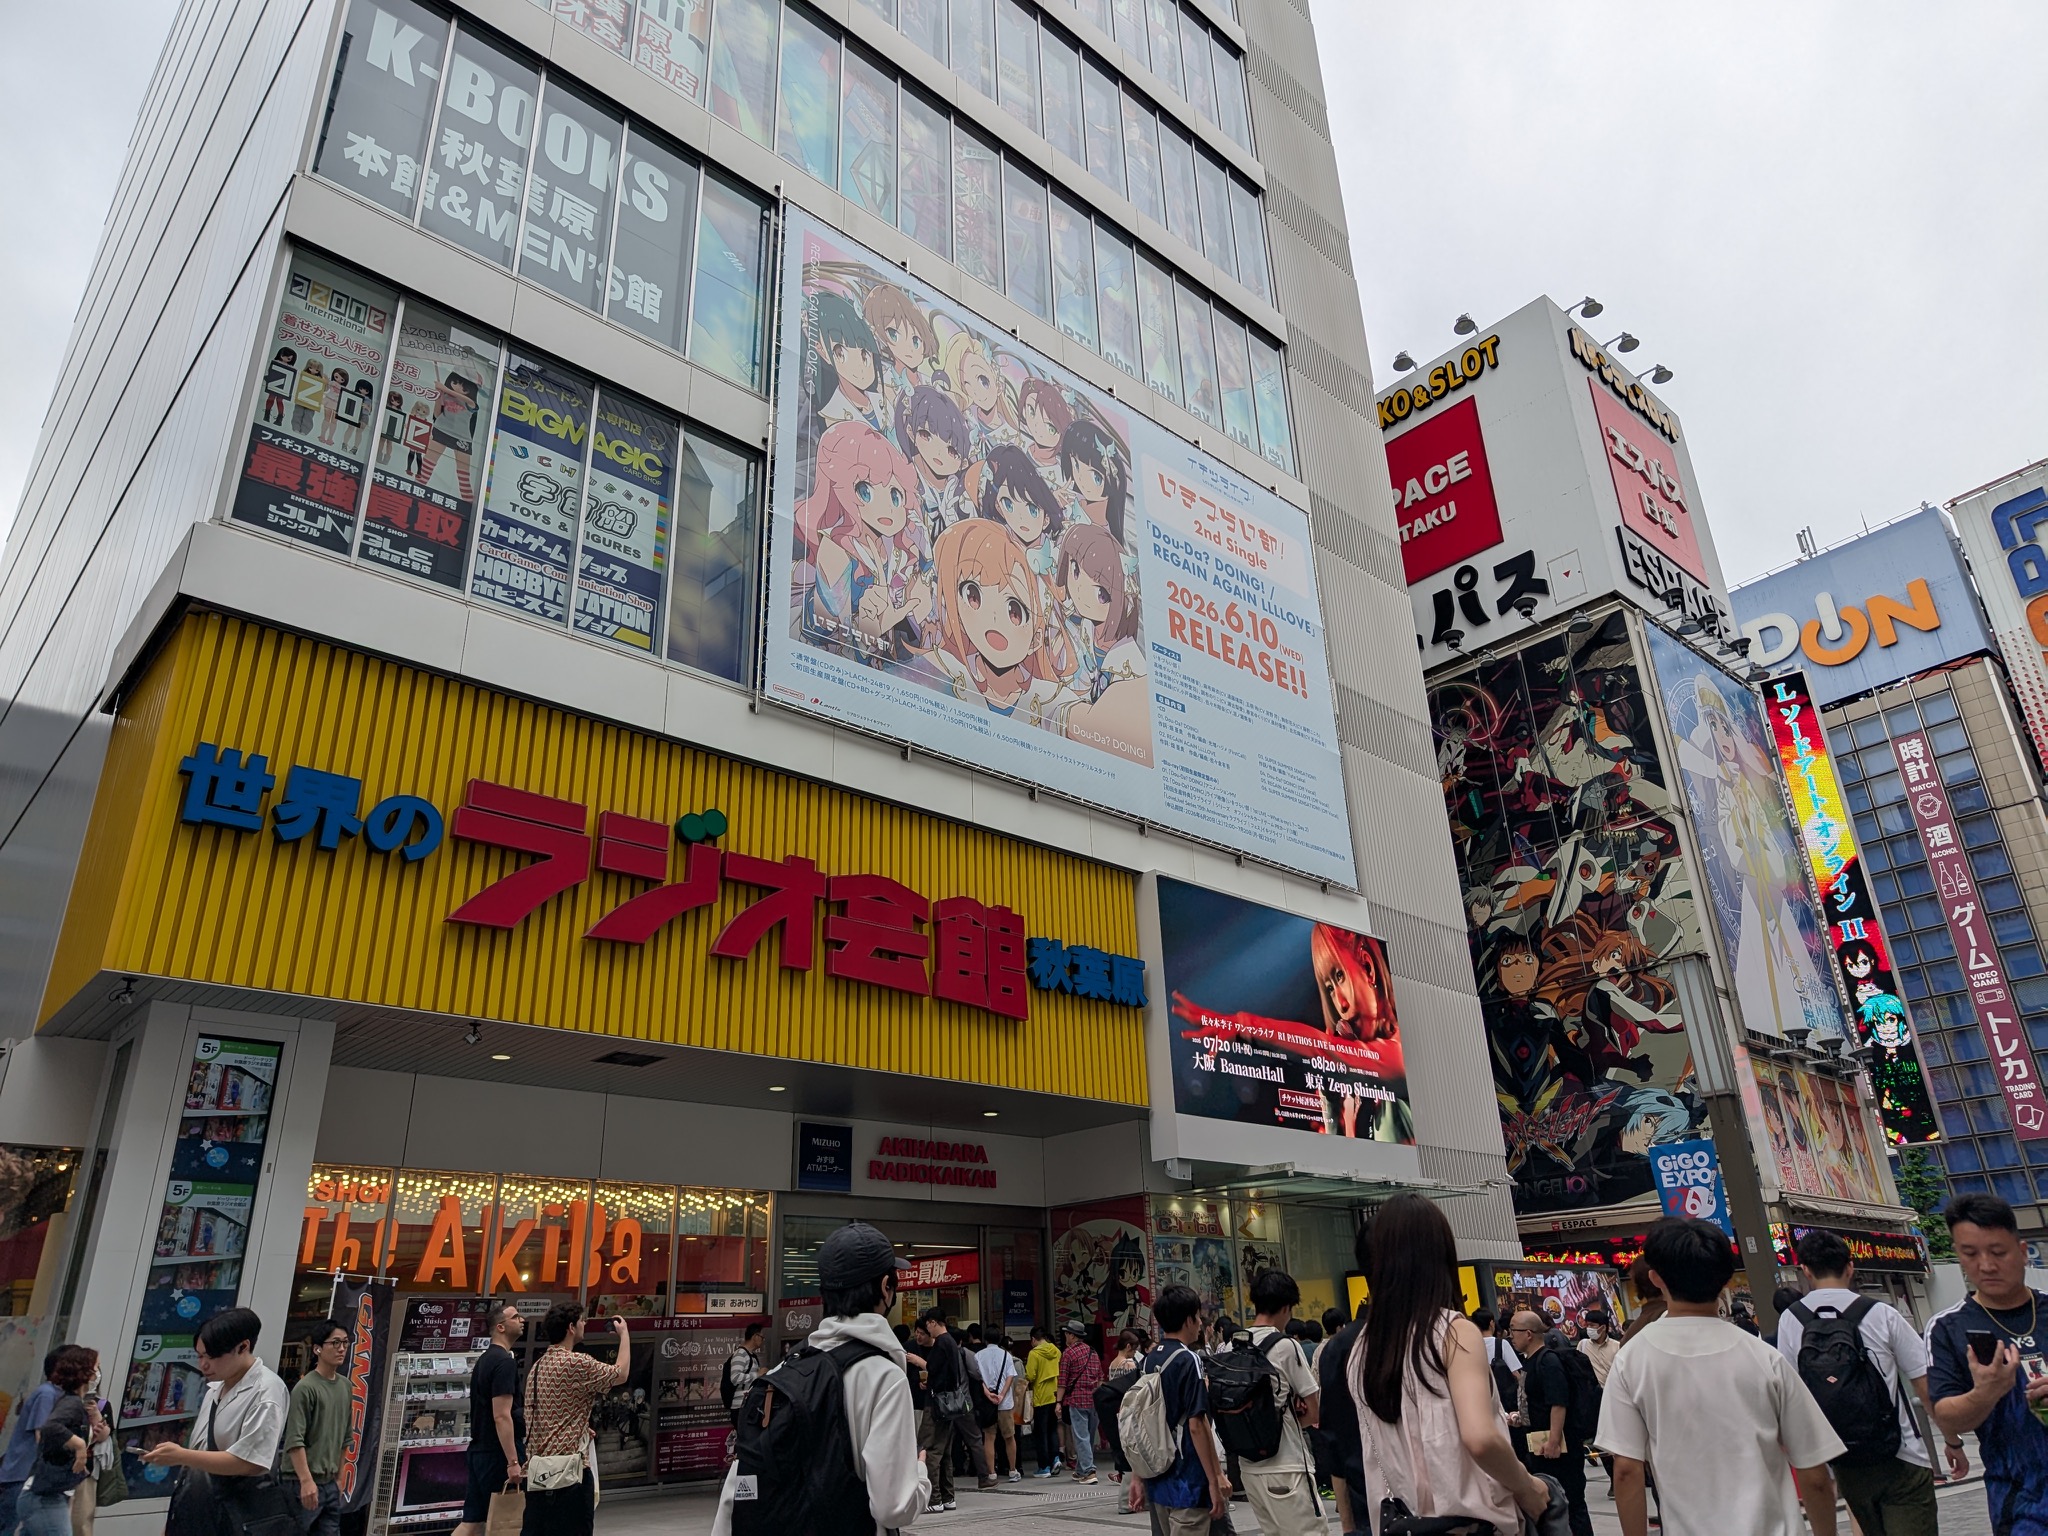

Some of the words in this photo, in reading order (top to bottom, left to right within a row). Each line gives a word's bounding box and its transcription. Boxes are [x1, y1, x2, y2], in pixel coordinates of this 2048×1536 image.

[366, 8, 670, 223] K-BOOKS
[440, 125, 601, 242] 秋葉原
[343, 128, 664, 325] 本館&MEN'S館
[811, 242, 820, 284] REGAIN
[289, 273, 387, 333] azone
[304, 303, 367, 335] International
[808, 287, 819, 326] AGAIN
[261, 430, 360, 474] フィギュア・おもちゃ
[373, 472, 458, 511] 中古買取・販売
[622, 465, 641, 480] CARD
[643, 474, 662, 487] SHOP
[1604, 426, 1688, 514] エスパス
[267, 513, 320, 538] ジャングル
[368, 547, 433, 575] 秋葉原2号店
[365, 520, 385, 532] OBBY
[387, 528, 408, 539] SHOP
[510, 502, 551, 526] TOYS
[558, 521, 569, 533] &
[583, 530, 642, 559] IGURES
[1193, 520, 1222, 546] 2nd
[1226, 537, 1268, 570] Single
[1153, 543, 1207, 582] REGAIN
[1213, 575, 1257, 608] AGAIN
[1215, 558, 1265, 593] DOING!
[474, 578, 620, 637] ホビーステション
[626, 594, 653, 612] Shop
[1417, 549, 1550, 651] パス
[1166, 580, 1279, 650] 2026.6.10
[1280, 644, 1304, 665] (WED)
[1168, 608, 1308, 699] RELEASE!!
[1073, 724, 1111, 746] Dou-Da?
[1112, 739, 1146, 759] DOING!
[1898, 737, 1932, 783] 時計
[1910, 780, 1937, 793] WATCH
[1926, 822, 1954, 848] 酒
[1931, 847, 1959, 859] ALCOHOL
[179, 742, 445, 864] 世界の
[444, 778, 1028, 1021] ラジオ会館
[1025, 937, 1149, 1008] 秋葉原
[1952, 901, 1994, 971] ゲーム
[1970, 970, 1998, 983] VIDEO
[1973, 976, 2000, 988] GAME
[201, 1042, 219, 1054] 5F
[1234, 1023, 1274, 1039] ワンマンライブ
[1277, 1031, 1285, 1040] RI
[1285, 1033, 1312, 1047] PATHOS
[1313, 1040, 1328, 1050] LIVE
[1328, 1043, 1336, 1051] in
[1336, 1044, 1380, 1061] OSAKA/TOKYO
[1987, 1011, 2028, 1081] トレカ
[1192, 1051, 1216, 1073] 大阪
[1219, 1057, 1285, 1083] BananaHall
[1304, 1072, 1325, 1091] 東京
[1327, 1077, 1353, 1098] Zepp
[1353, 1082, 1396, 1103] Shinjuku
[2005, 1082, 2036, 1093] TRADING
[2013, 1089, 2034, 1100] CARD
[812, 1137, 841, 1148] MIZUHO
[879, 1136, 989, 1164] AKIHABARA
[806, 1163, 844, 1173] ATMコーナー
[816, 1155, 835, 1164] みずほ
[868, 1160, 997, 1189] RADIOKAIKAN
[1657, 1151, 1710, 1171] GiGO
[172, 1184, 189, 1196] 5F
[1661, 1167, 1712, 1188] EXPO
[1562, 1218, 1598, 1229] ESPACE
[302, 1207, 399, 1274] The
[917, 1259, 962, 1285] 買取センター
[710, 1299, 726, 1308] 東京
[729, 1298, 758, 1308] おみやげ
[653, 1318, 703, 1329] 好評発売中!
[141, 1339, 159, 1352] 5F
[705, 1344, 724, 1355] Ave
[341, 1292, 373, 1503] GAMERS
